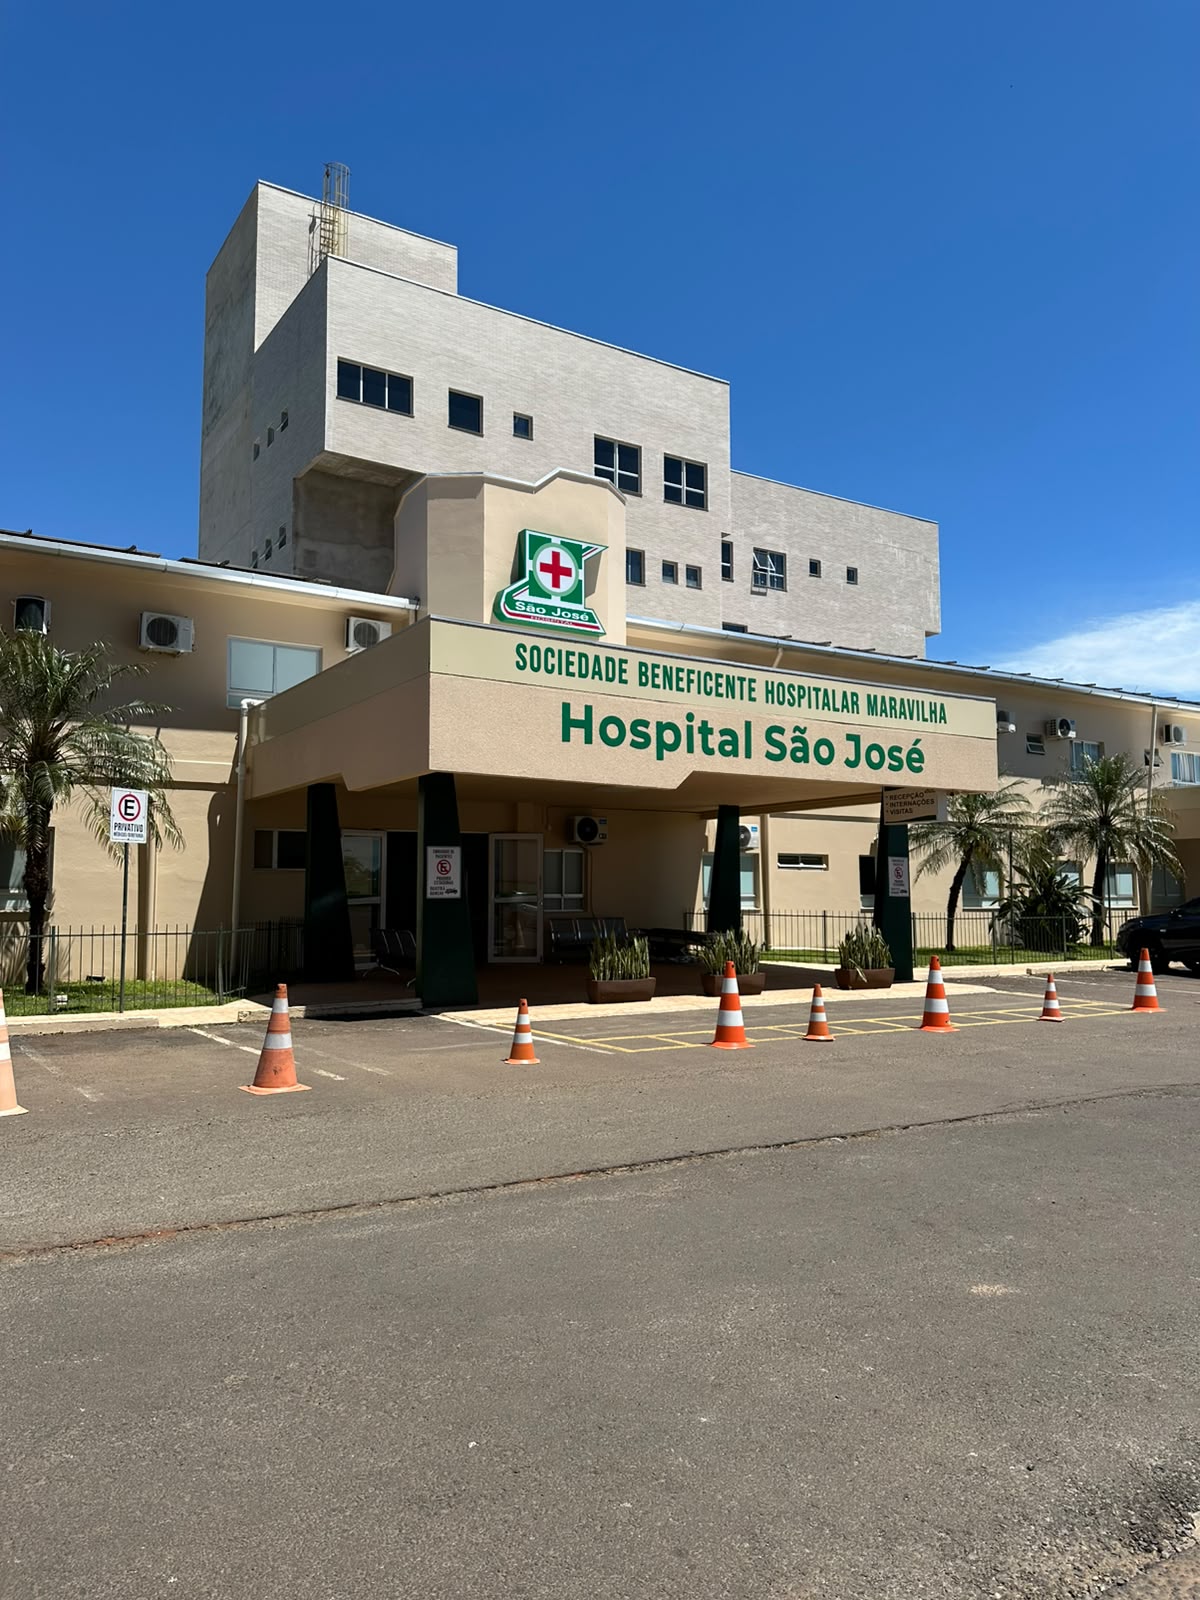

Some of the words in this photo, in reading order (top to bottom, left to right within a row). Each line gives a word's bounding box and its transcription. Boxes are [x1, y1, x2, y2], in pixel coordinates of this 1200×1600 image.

[515, 601, 546, 615] São
[551, 607, 589, 621] José
[515, 642, 629, 685] SOCIEDADE
[638, 661, 757, 702] BENEFICENTE
[765, 680, 860, 715] HOSPITALAR
[866, 693, 947, 724] MARAVILHA
[561, 701, 752, 761] Hospital
[764, 724, 835, 766] São
[844, 733, 925, 774] José
[890, 792, 924, 800] RECEPÇÃO
[124, 799, 135, 816] E
